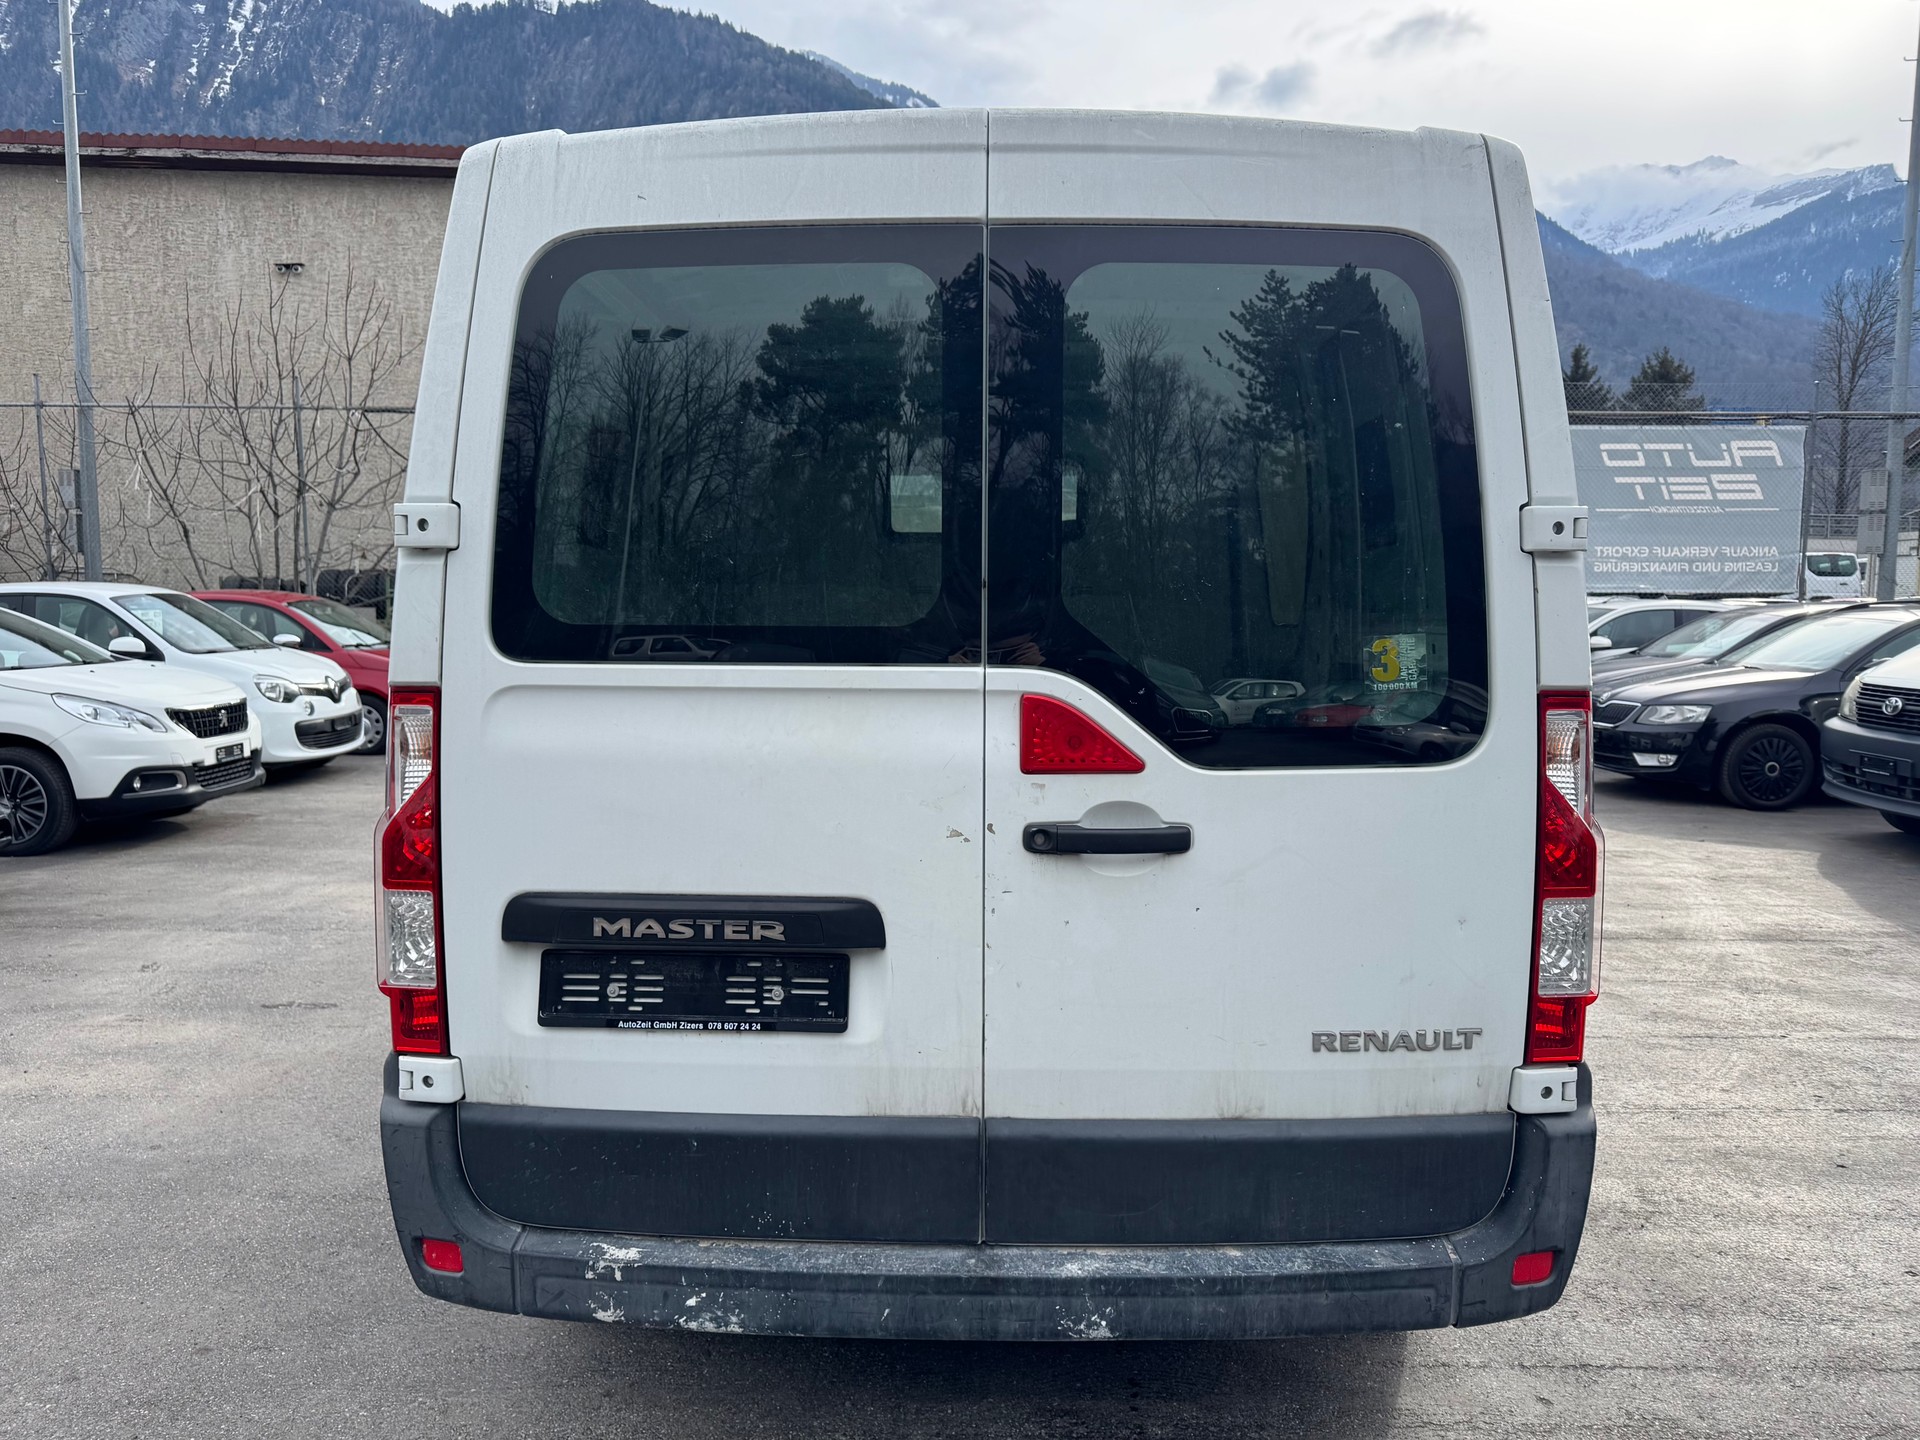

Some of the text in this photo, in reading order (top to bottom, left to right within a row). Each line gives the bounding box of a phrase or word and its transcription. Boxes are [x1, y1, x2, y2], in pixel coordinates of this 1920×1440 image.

[1372, 638, 1400, 682] 3
[1405, 681, 1418, 689] KM
[593, 917, 785, 941] MASTER
[618, 1020, 651, 1028] AutoZeit
[654, 1021, 677, 1029] GmbH
[708, 1022, 721, 1030] 078
[724, 1022, 738, 1030] 607
[1312, 1027, 1482, 1052] RENAULT
